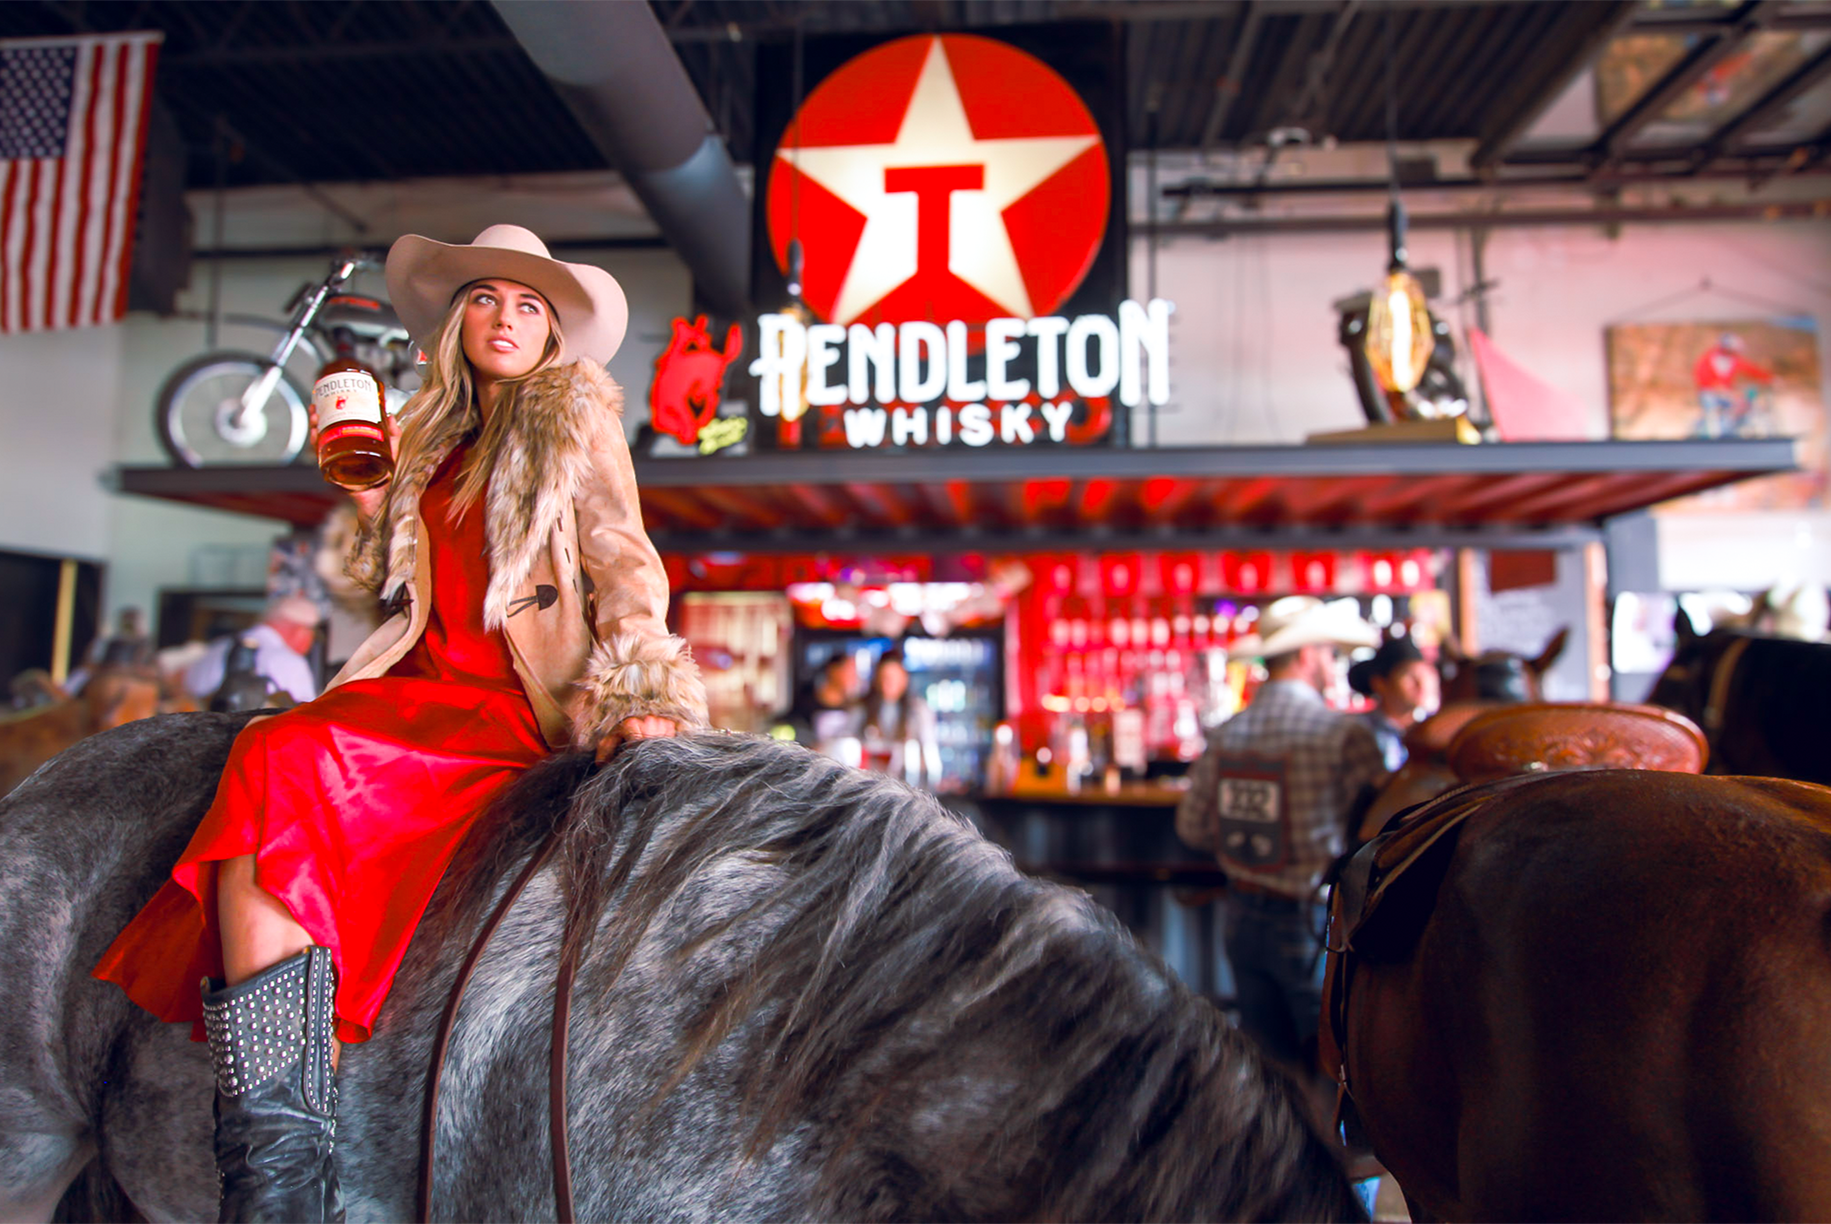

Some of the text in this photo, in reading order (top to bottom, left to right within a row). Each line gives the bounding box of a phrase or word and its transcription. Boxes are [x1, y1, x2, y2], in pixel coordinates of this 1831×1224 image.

[749, 299, 1169, 421] PENDLETON
[315, 378, 372, 396] PENDLETON
[843, 401, 1073, 447] WHISKY
